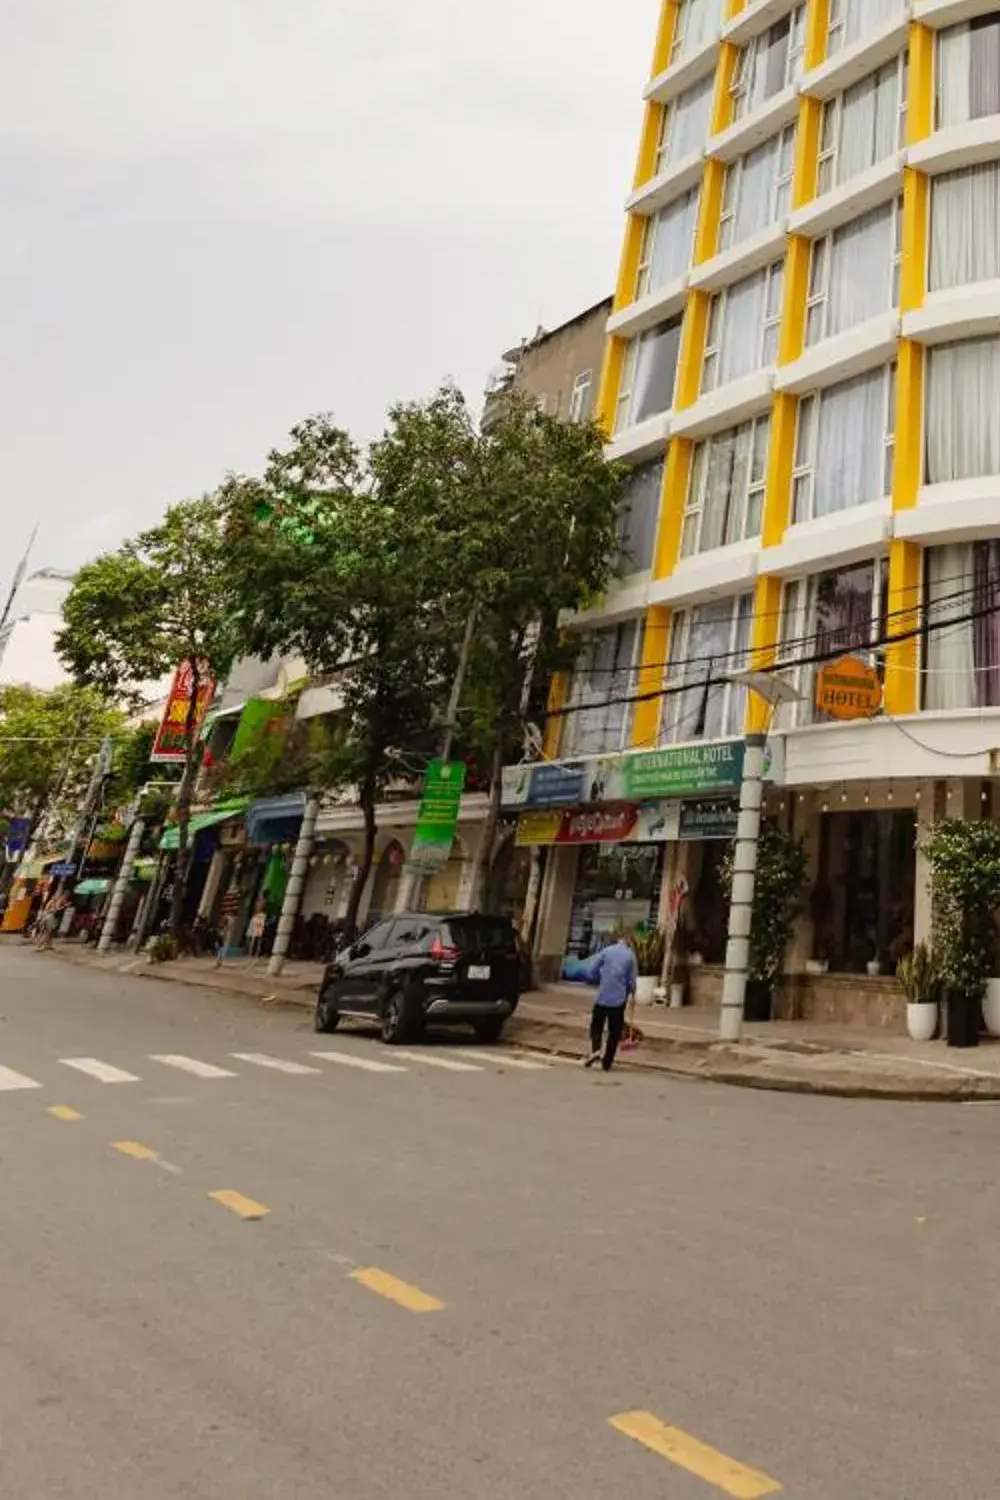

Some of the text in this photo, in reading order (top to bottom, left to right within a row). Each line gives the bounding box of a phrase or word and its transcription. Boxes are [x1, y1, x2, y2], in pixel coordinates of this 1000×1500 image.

[823, 690, 874, 709] HOTEL
[634, 745, 734, 768] INTERNATIONAL HOTEL
